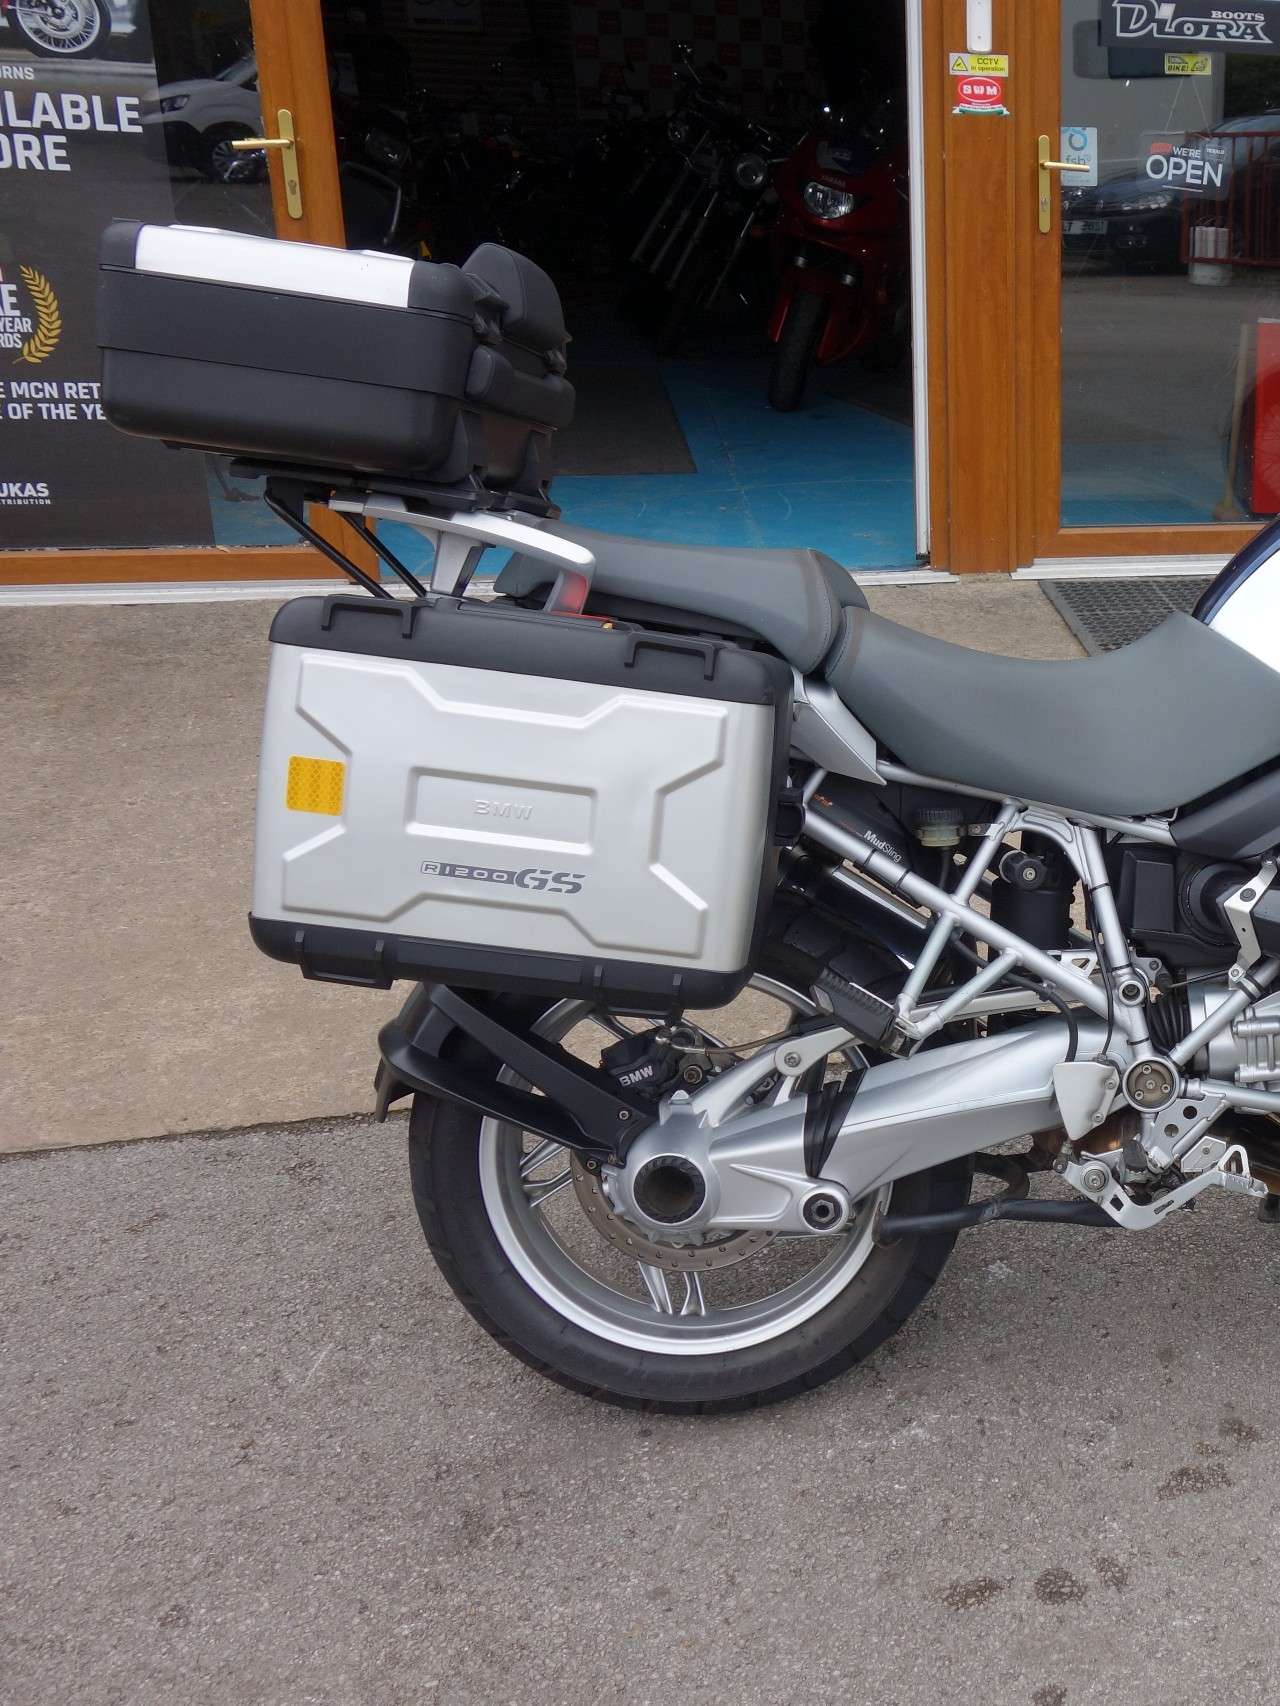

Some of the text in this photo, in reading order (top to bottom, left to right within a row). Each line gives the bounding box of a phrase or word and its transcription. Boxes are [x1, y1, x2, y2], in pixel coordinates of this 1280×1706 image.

[1211, 10, 1265, 21] BOOTS
[977, 57, 999, 65] CCTV
[0, 65, 35, 80] RNS
[962, 84, 998, 96] SWM
[1146, 155, 1223, 187] OPEN
[11, 382, 58, 398] MCN
[64, 382, 101, 399] RET
[8, 403, 33, 419] OF
[38, 403, 78, 420] THE
[474, 799, 534, 820] BMW
[864, 830, 902, 865] MudSling
[620, 1066, 654, 1087] BMW
